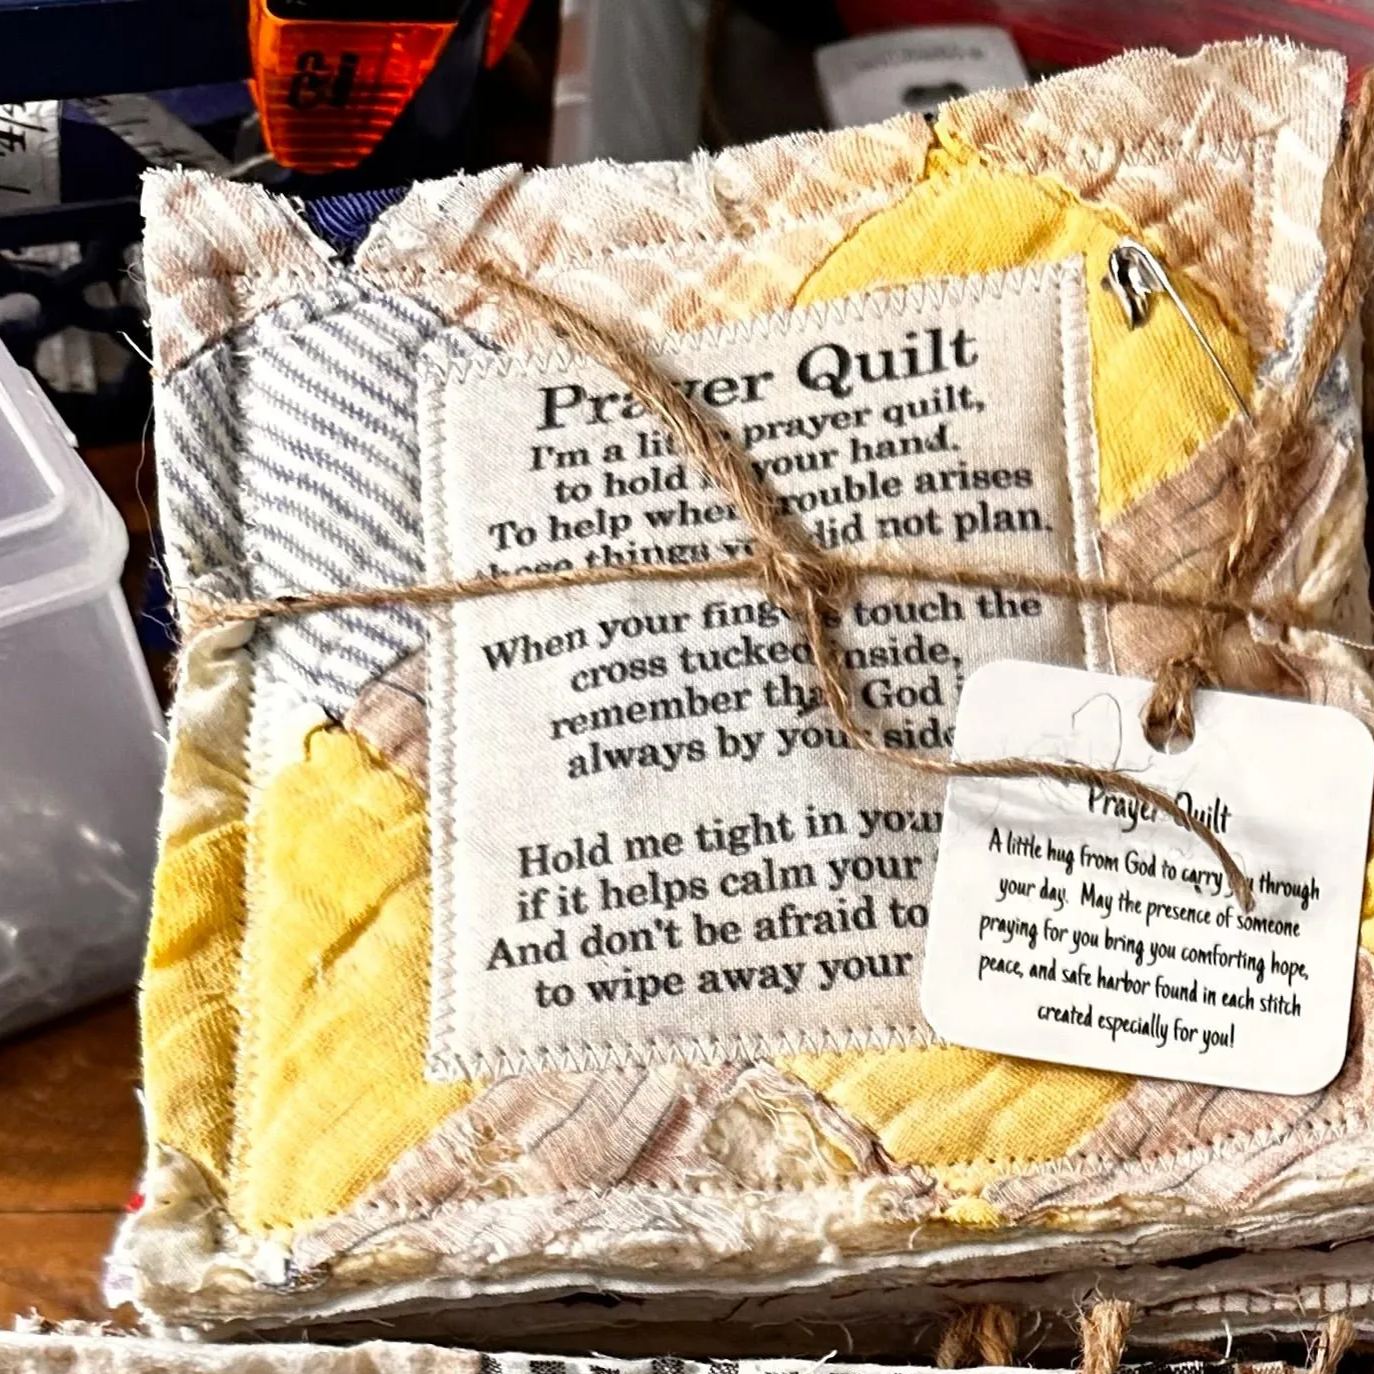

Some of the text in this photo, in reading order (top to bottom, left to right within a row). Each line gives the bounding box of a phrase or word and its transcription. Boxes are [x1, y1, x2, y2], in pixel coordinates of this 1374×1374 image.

[798, 327, 979, 396] Quilt
[529, 383, 986, 473] I'm a prayer quilt,
[518, 805, 943, 880] Hold me tight in you
[517, 851, 923, 922] if it helps calm your
[486, 895, 929, 970] And don't be afraid to
[535, 949, 914, 1009] to wipe away your
[978, 955, 1300, 1016] peace, and safe harbor found in each stitch
[1037, 1004, 1234, 1053] created especially for you!
